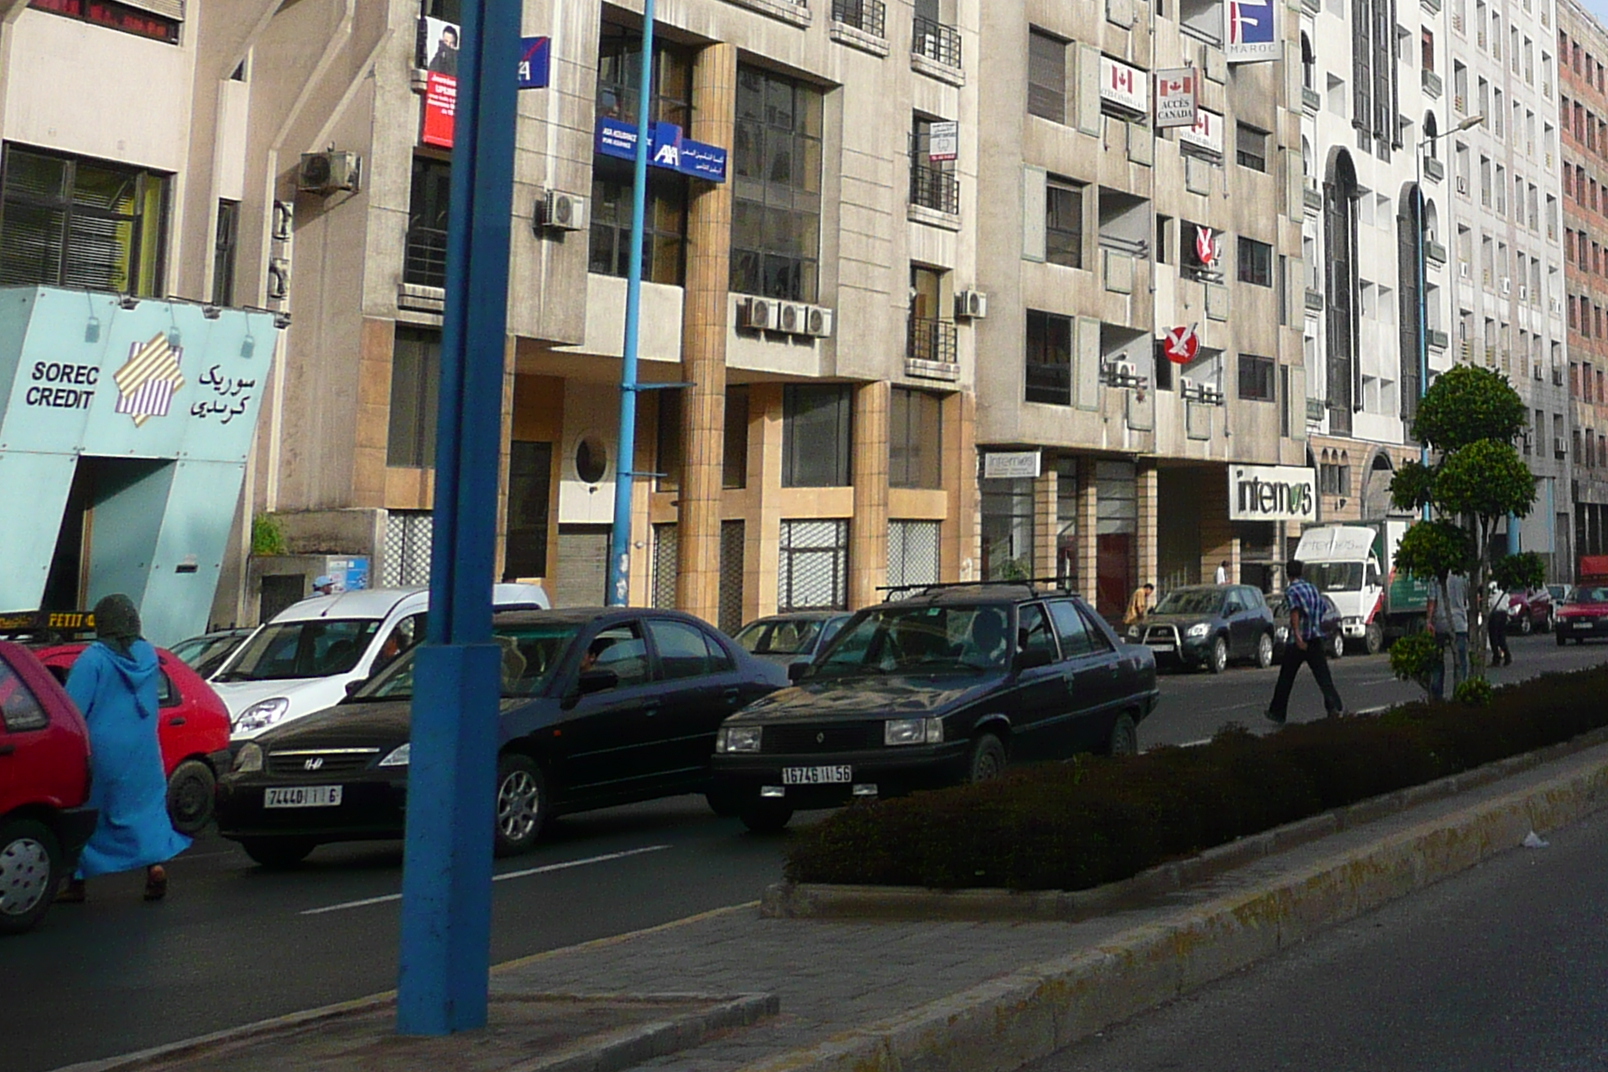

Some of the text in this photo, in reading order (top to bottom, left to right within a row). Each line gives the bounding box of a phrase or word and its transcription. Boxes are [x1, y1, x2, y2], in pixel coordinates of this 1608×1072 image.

[1230, 44, 1275, 54] MAROC
[1158, 109, 1193, 120] CANADA
[654, 144, 679, 166] AXA
[32, 361, 100, 385] SOREC
[26, 386, 95, 409] CREDIT
[49, 612, 83, 627] PETIT
